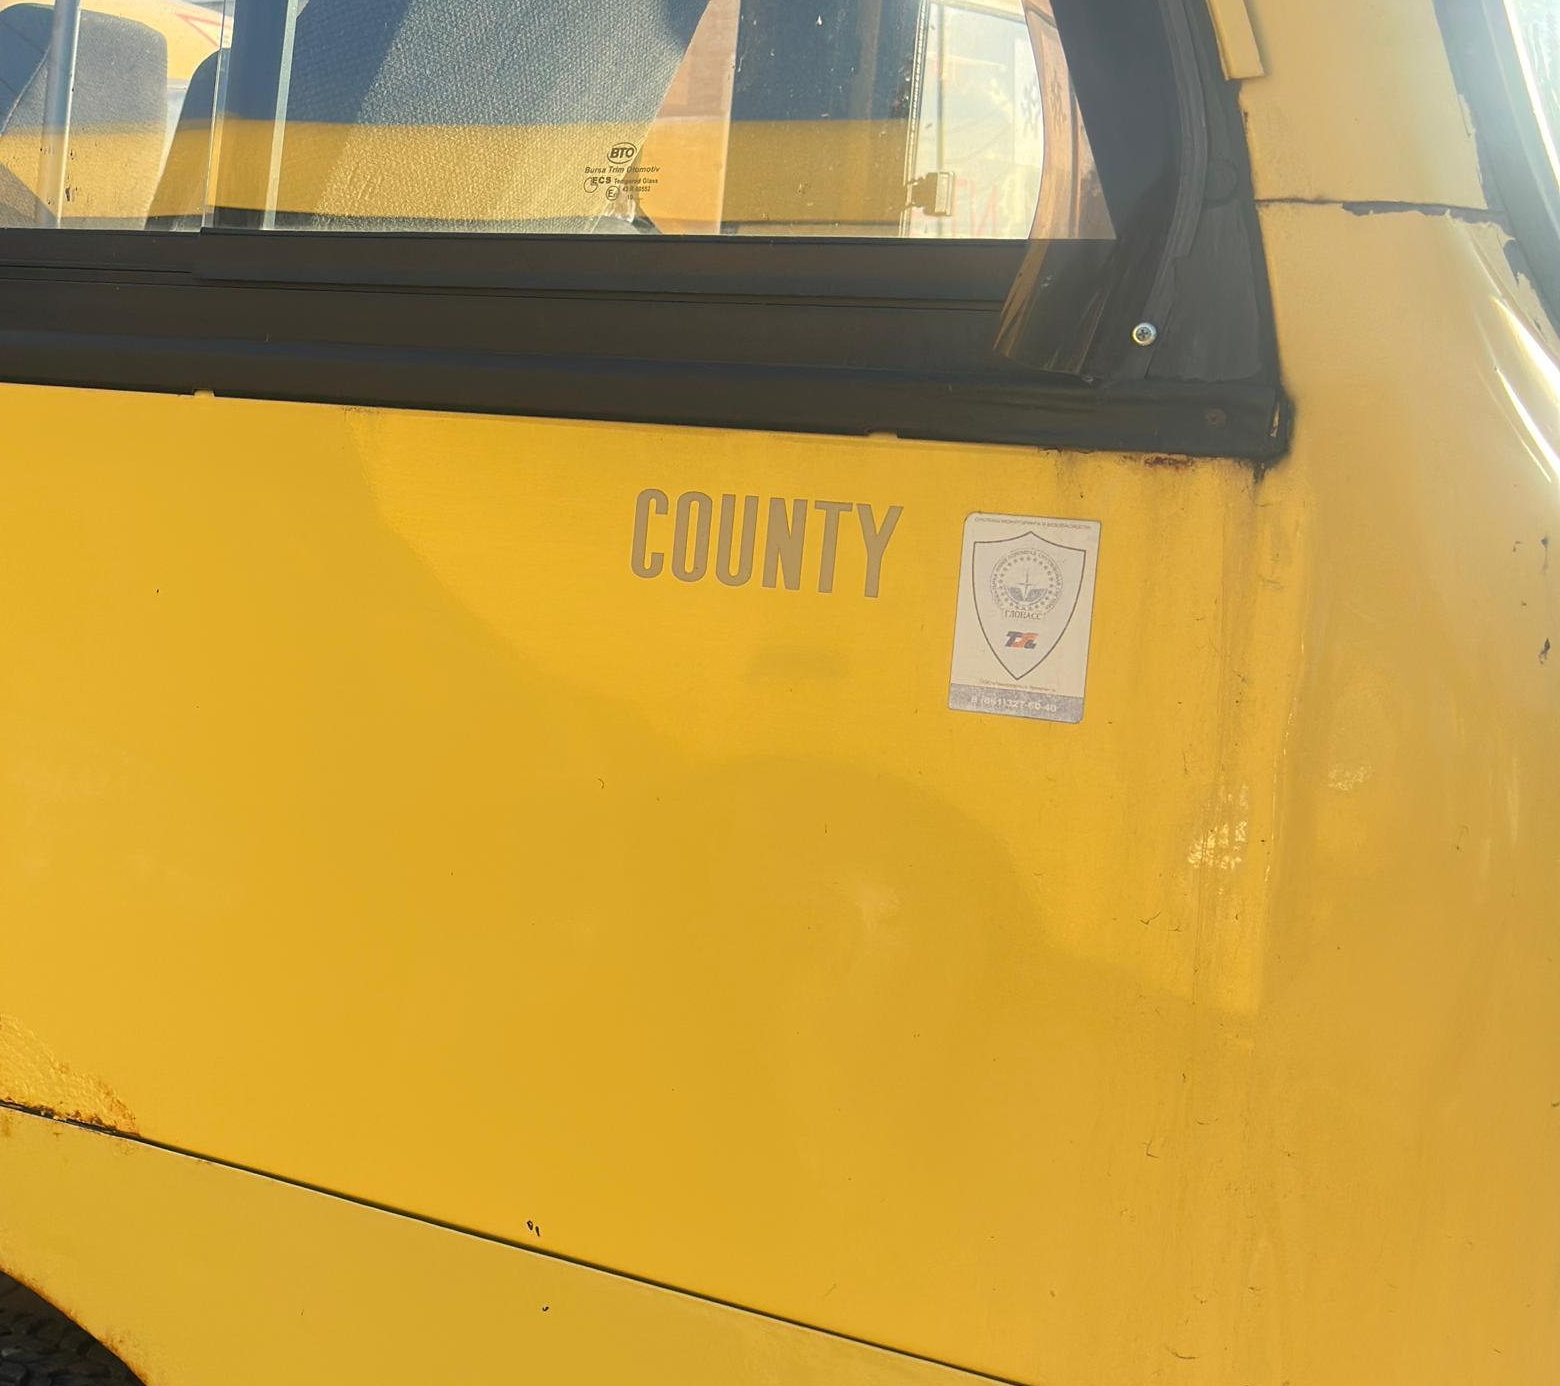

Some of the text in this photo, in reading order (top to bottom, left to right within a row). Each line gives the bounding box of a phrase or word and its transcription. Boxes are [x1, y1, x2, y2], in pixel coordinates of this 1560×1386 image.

[610, 147, 635, 159] BTO
[584, 166, 606, 174] Bursa
[631, 488, 904, 598] COUNTY
